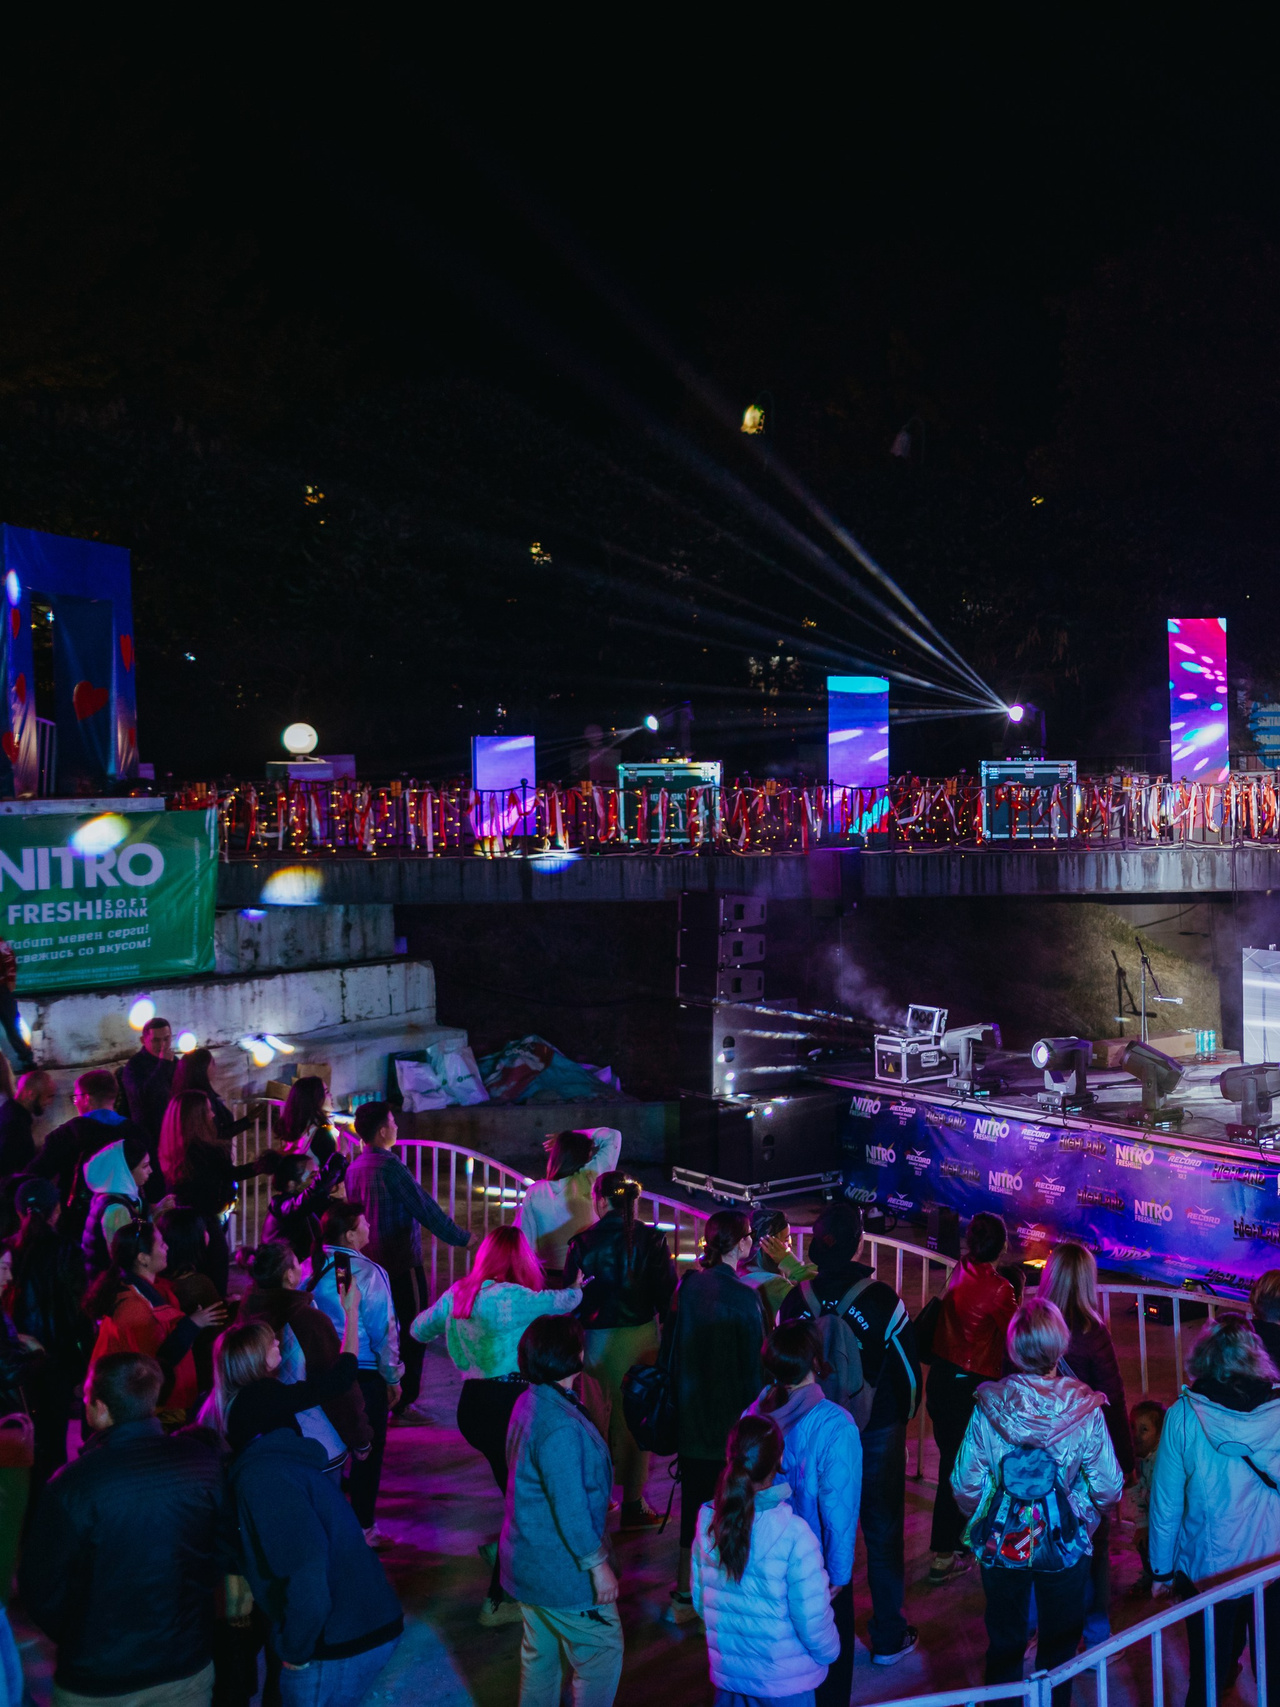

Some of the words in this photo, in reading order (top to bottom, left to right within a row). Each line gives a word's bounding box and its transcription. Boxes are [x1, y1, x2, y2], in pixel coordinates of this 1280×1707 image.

[0, 842, 164, 892] NITRO
[8, 899, 103, 925] FRESH!
[105, 897, 148, 909] SOFT
[104, 907, 148, 919] DRINK
[58, 931, 103, 945] менен
[107, 923, 149, 939] серги!
[15, 949, 74, 964] свежись
[78, 946, 94, 956] со
[98, 937, 151, 954] вкусом!
[850, 1096, 881, 1115] NITRO
[973, 1118, 1010, 1138] NITRO
[1021, 1129, 1051, 1140] RECORD
[865, 1144, 896, 1163] NITRO
[1059, 1135, 1107, 1155] HIGHLAND
[1116, 1143, 1154, 1165] NITRO
[905, 1154, 932, 1165] RECORD
[1168, 1155, 1202, 1167] RECORD
[988, 1170, 1023, 1191] NITRO
[1212, 1163, 1266, 1185] HIGHLAND
[844, 1185, 878, 1203] NITRO
[1035, 1181, 1066, 1193] RECORD
[1077, 1184, 1125, 1211] HIGHLAND
[1134, 1199, 1174, 1222] NITRO
[1187, 1212, 1221, 1225] RECORD
[1016, 1226, 1046, 1239] RECORD
